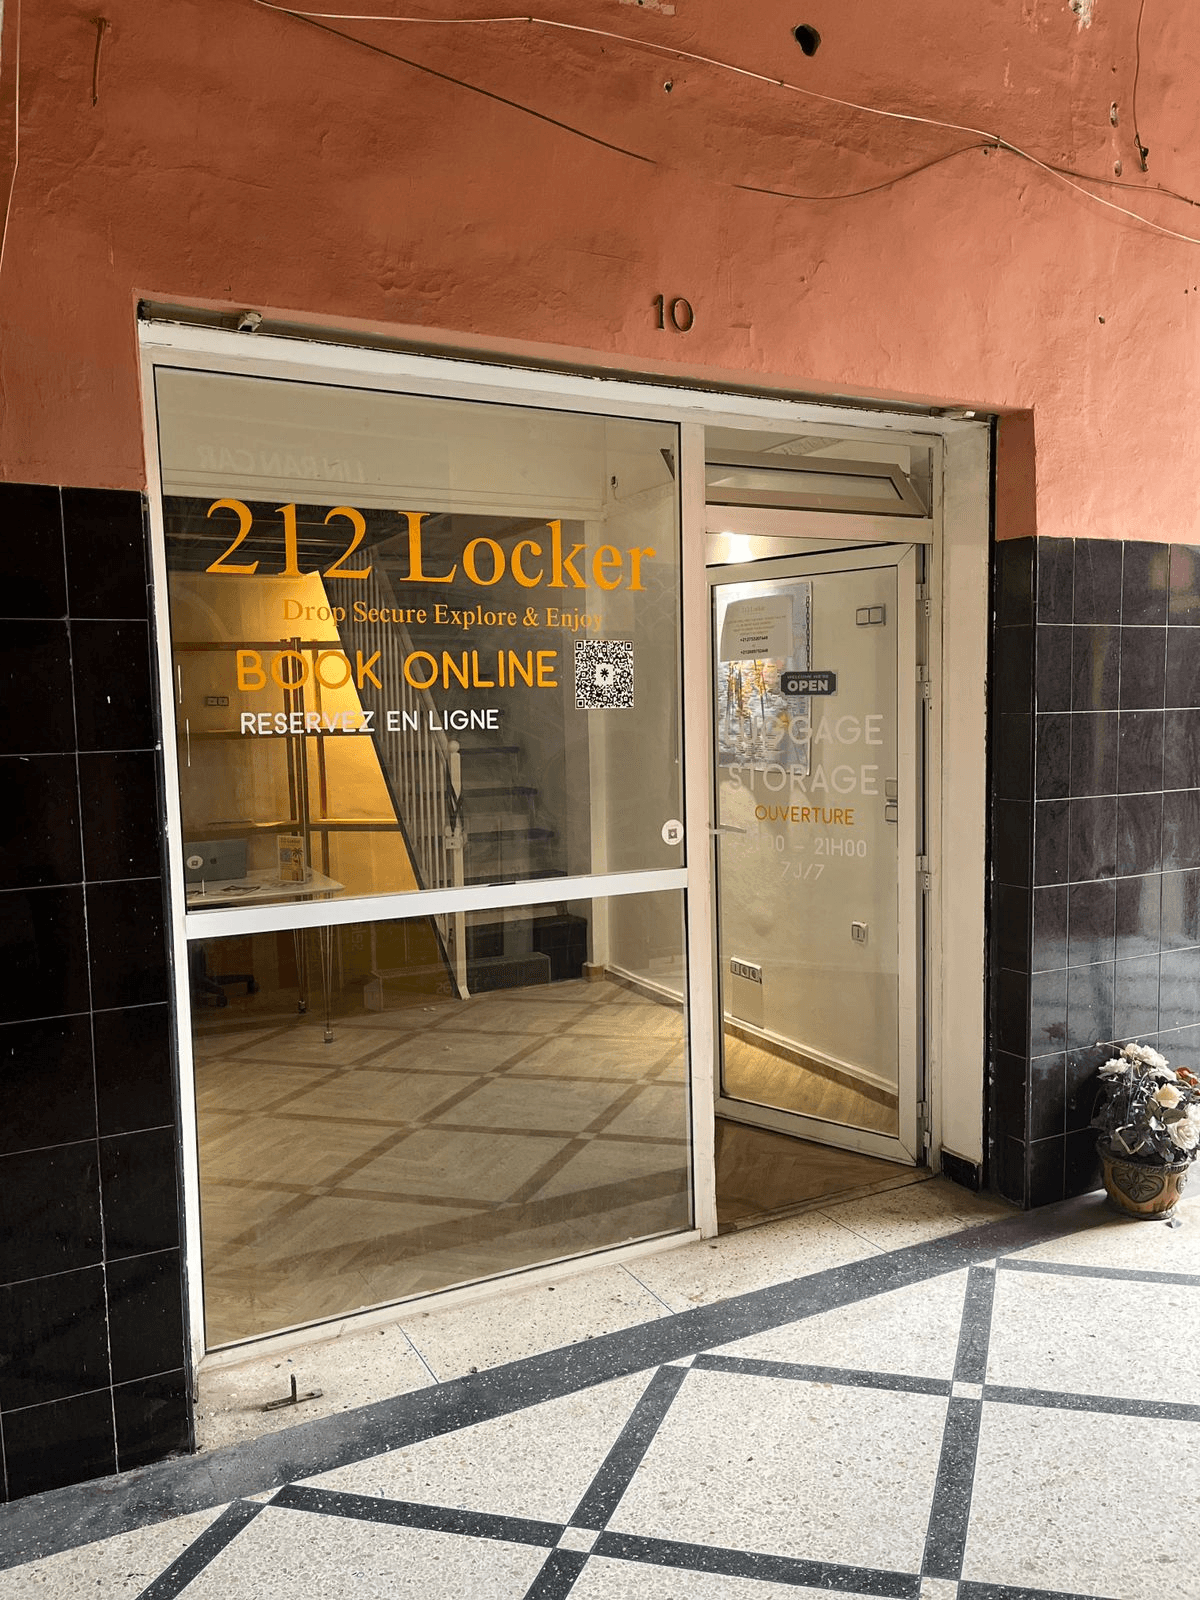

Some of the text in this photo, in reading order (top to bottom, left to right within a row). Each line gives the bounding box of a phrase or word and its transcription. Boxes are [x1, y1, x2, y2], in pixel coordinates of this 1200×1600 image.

[651, 293, 694, 332] 10
[205, 498, 657, 592] 212 Locker
[283, 599, 603, 632] Drop Secure Explore & Enjoy
[236, 649, 559, 691] BOOK ONLINE
[787, 680, 829, 692] OPEN
[240, 709, 500, 735] RESERVEZ EN LIGNE
[725, 714, 884, 745] LUGGAGE
[728, 763, 880, 795] STORAGE
[755, 805, 855, 825] OUVERTURE
[814, 837, 867, 858] 21H00
